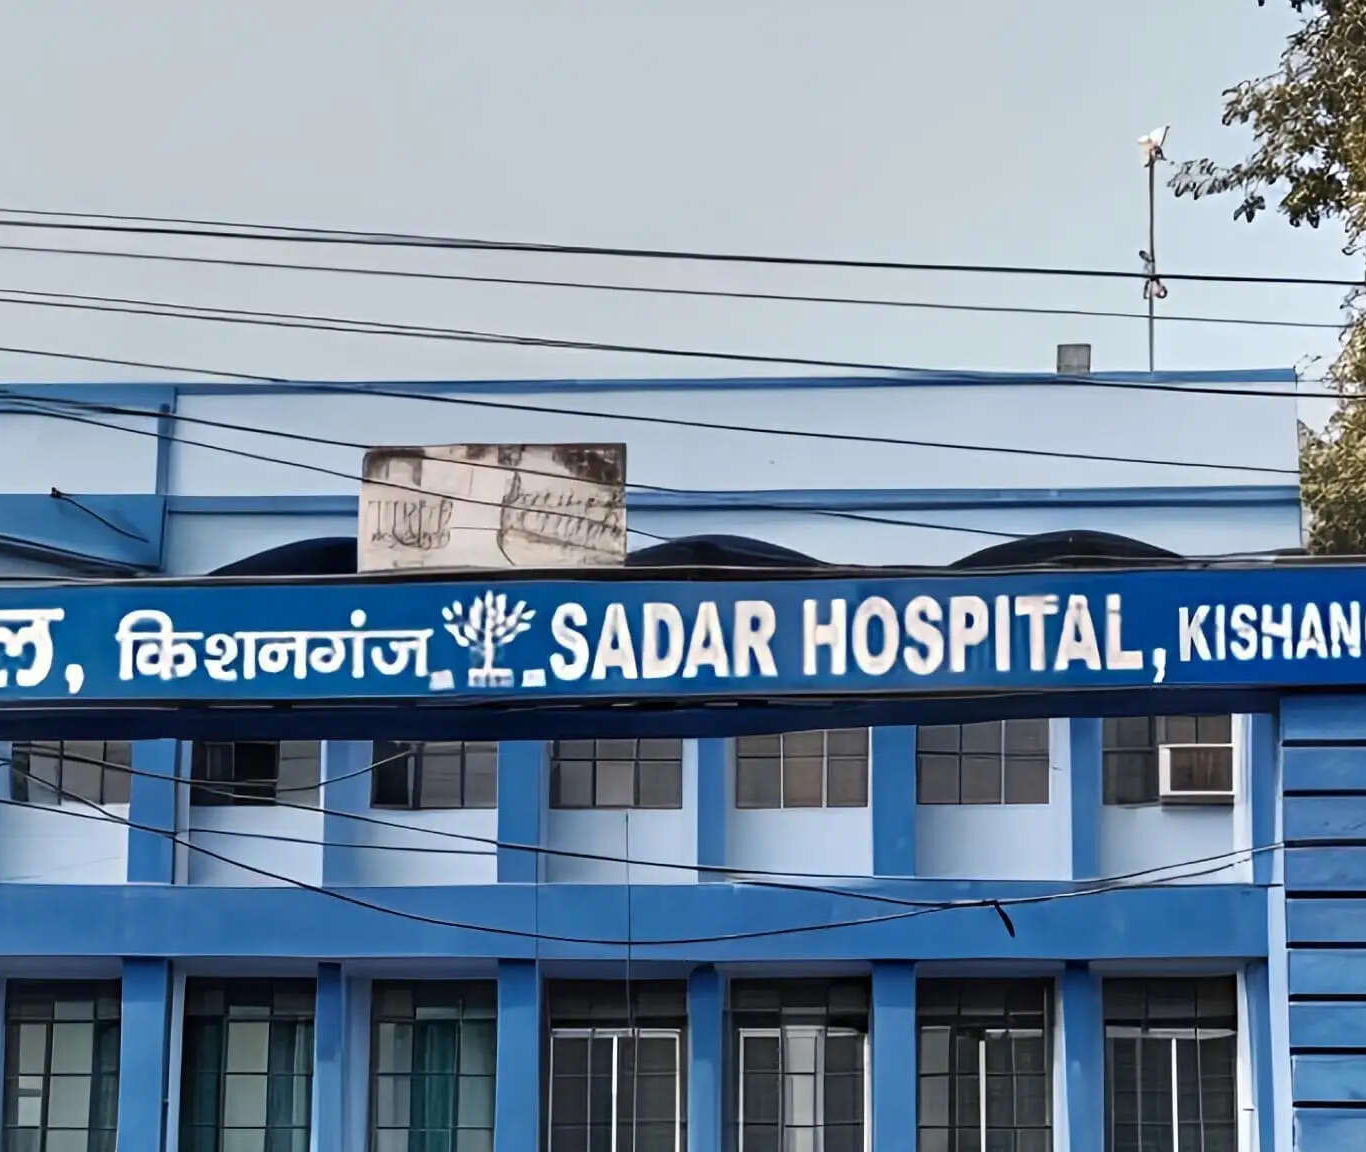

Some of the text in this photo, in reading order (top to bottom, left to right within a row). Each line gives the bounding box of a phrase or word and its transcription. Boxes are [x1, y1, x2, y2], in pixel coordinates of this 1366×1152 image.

[115, 609, 434, 682] किशनगंज
[549, 600, 778, 681] SADAR
[803, 593, 1166, 684] HOSPITAL,
